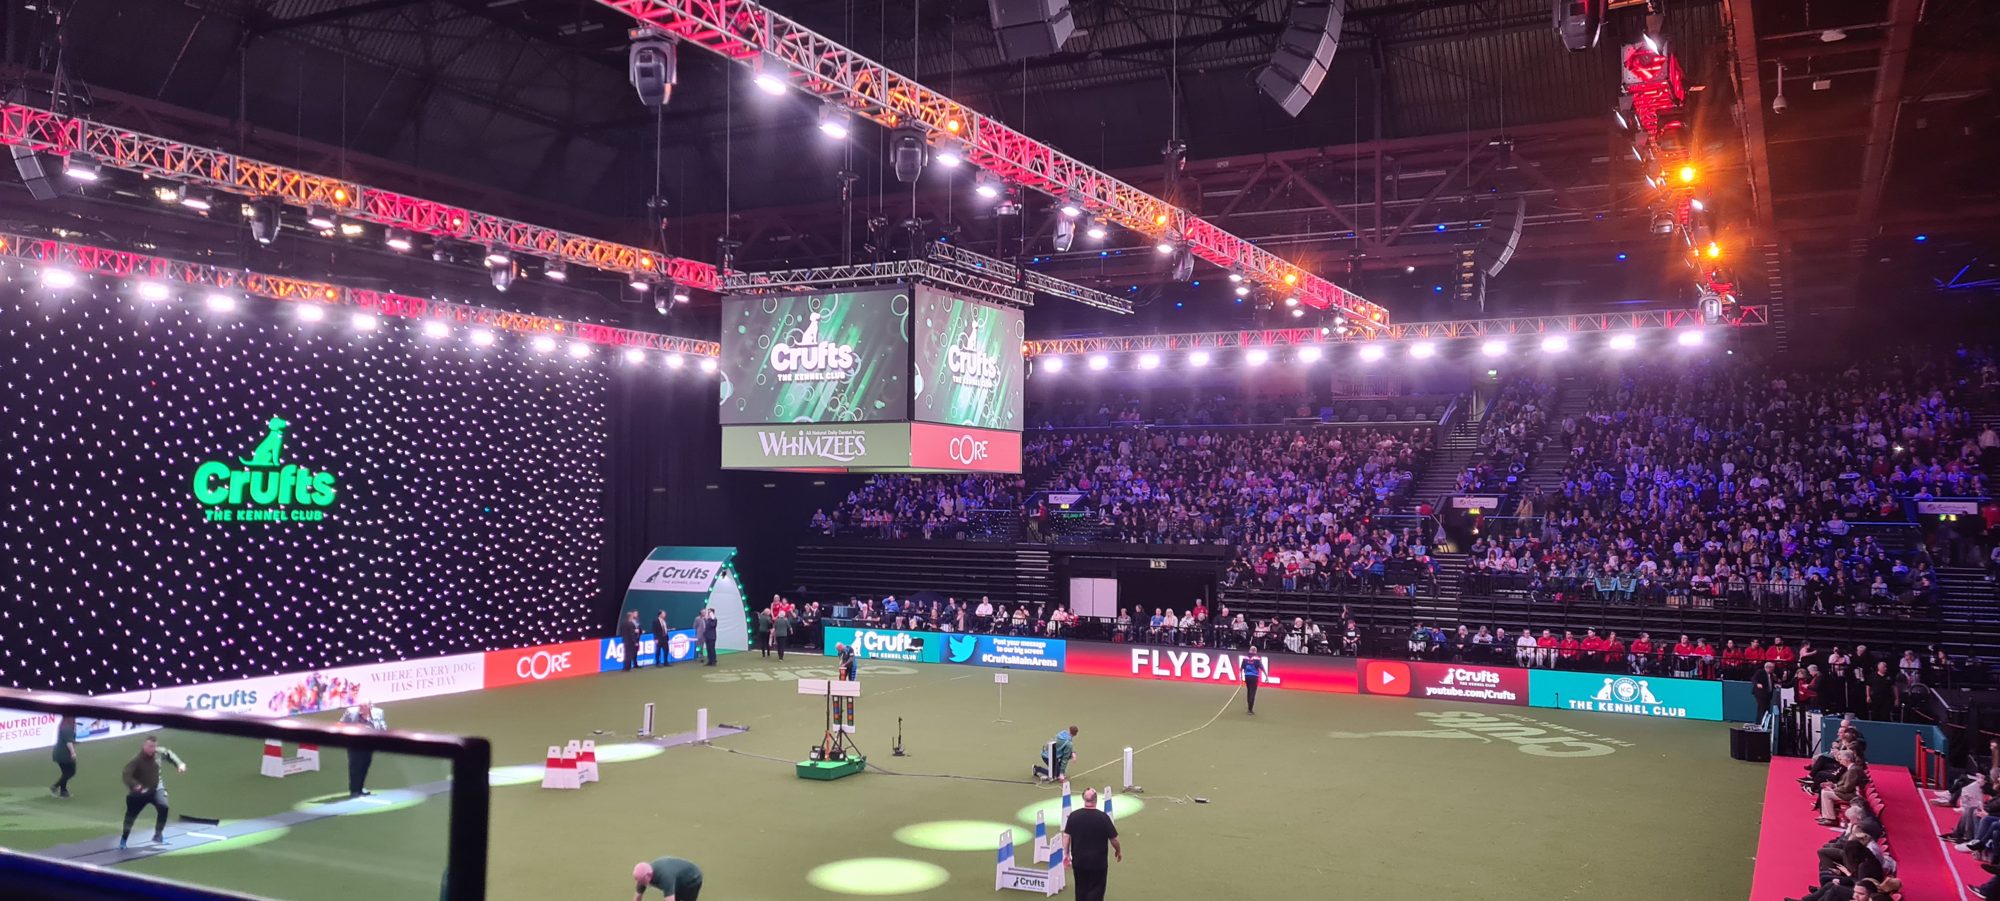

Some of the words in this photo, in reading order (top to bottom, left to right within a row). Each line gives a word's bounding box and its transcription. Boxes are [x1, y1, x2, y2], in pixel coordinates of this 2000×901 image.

[771, 341, 853, 371] Crufts
[948, 344, 997, 379] Crufts
[777, 373, 792, 381] THE
[795, 372, 824, 381] KENNEL
[825, 371, 846, 379] CLUB
[950, 435, 989, 464] CORE
[193, 461, 336, 506] Crufts
[205, 509, 232, 521] THE
[237, 509, 288, 521] KENNEL
[291, 510, 323, 521] CLUB
[662, 566, 710, 580] Crufts
[863, 631, 923, 653] Cruft
[993, 637, 1007, 645] Post
[1020, 641, 1047, 649] message
[1014, 646, 1023, 655] big
[517, 651, 571, 679] CORE
[982, 653, 1058, 668] #CruftsMainArena
[371, 669, 413, 682] WHERE
[416, 665, 449, 679] EVERY
[453, 662, 476, 673] DOG
[1455, 668, 1500, 683] Crufts
[391, 681, 413, 692] HAS
[417, 679, 433, 689] ITS
[437, 676, 457, 686] DAY
[1620, 686, 1632, 694] KC
[197, 689, 257, 710] Crufts
[1426, 687, 1516, 700] youtube.com/Crufts
[1569, 700, 1593, 710] THE
[1598, 702, 1648, 714] KENNEL
[1653, 706, 1686, 717] CLUB
[0, 714, 55, 730] NUTRITION
[1020, 877, 1045, 888] Crufts
